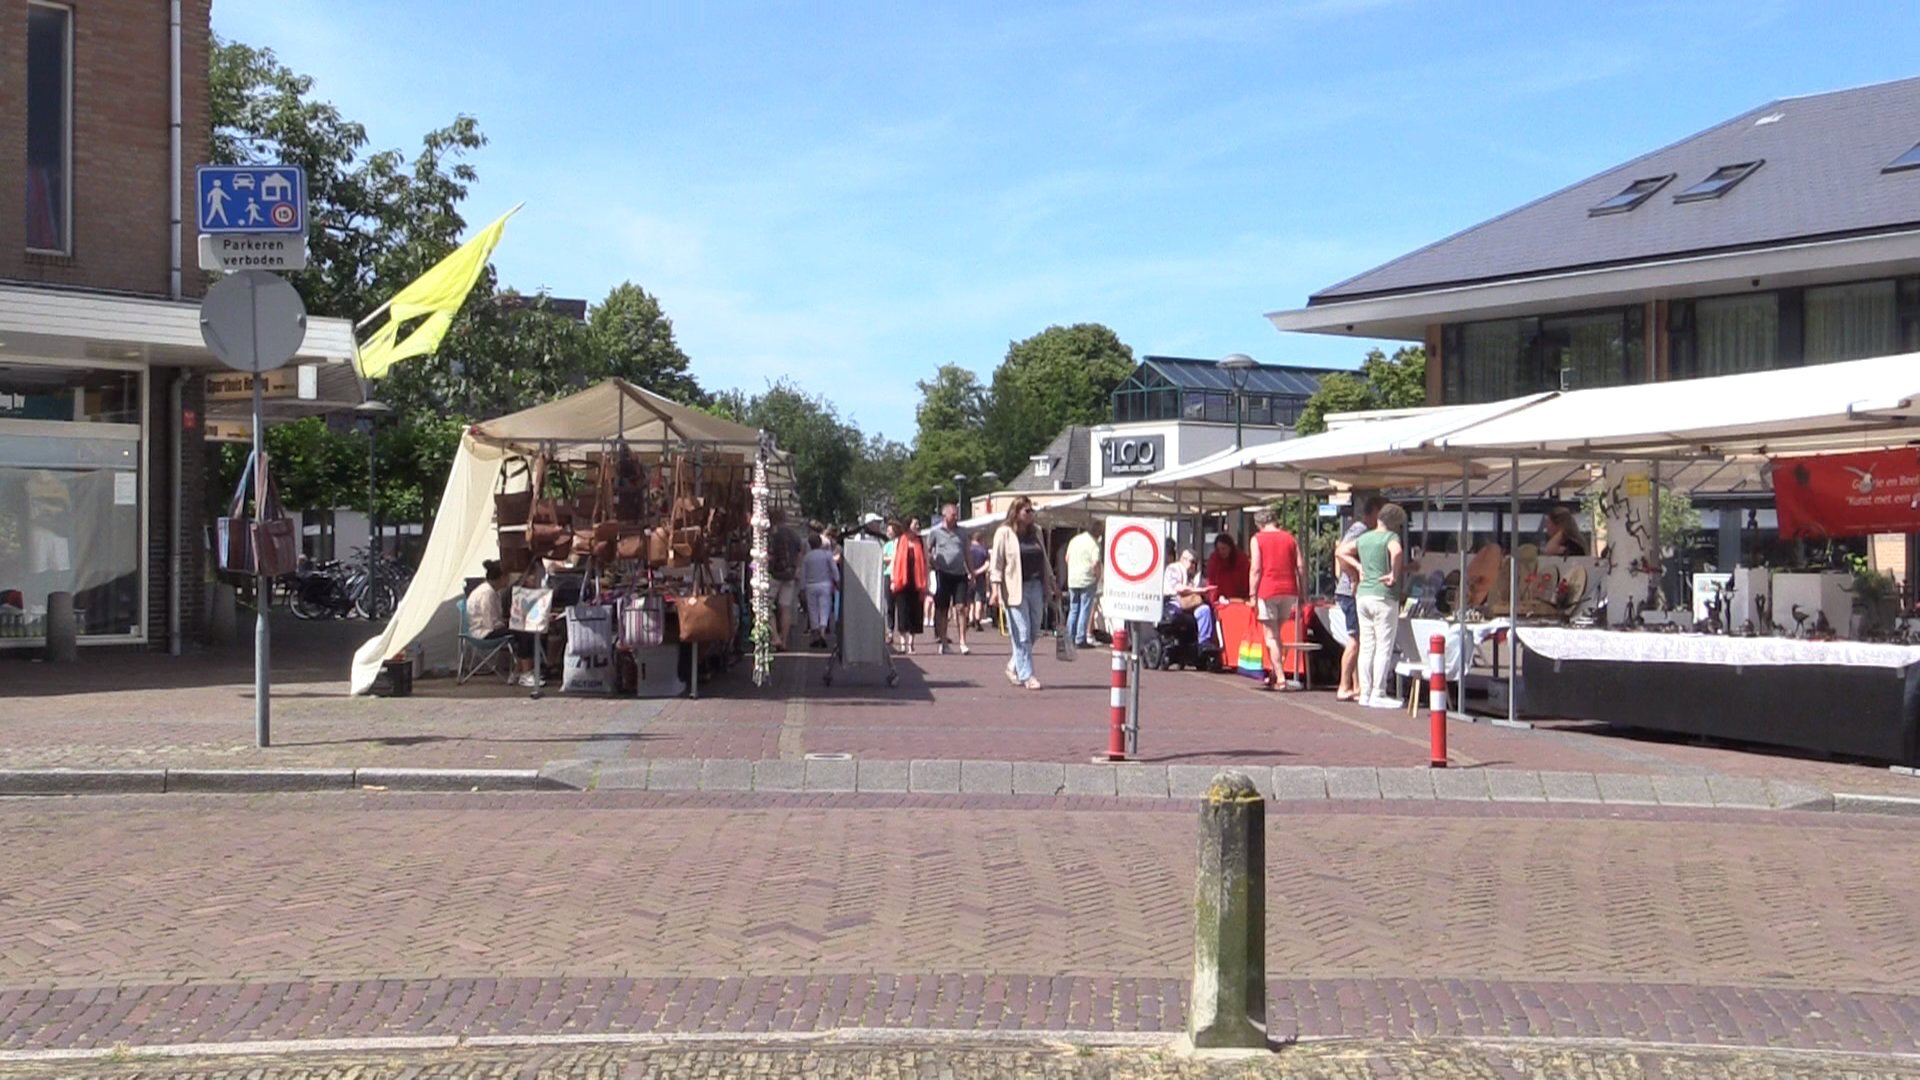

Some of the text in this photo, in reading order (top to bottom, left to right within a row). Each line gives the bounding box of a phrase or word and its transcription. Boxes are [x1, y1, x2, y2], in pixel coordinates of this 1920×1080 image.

[278, 209, 290, 219] 15
[223, 239, 284, 250] Parkeren
[223, 255, 284, 265] verboden
